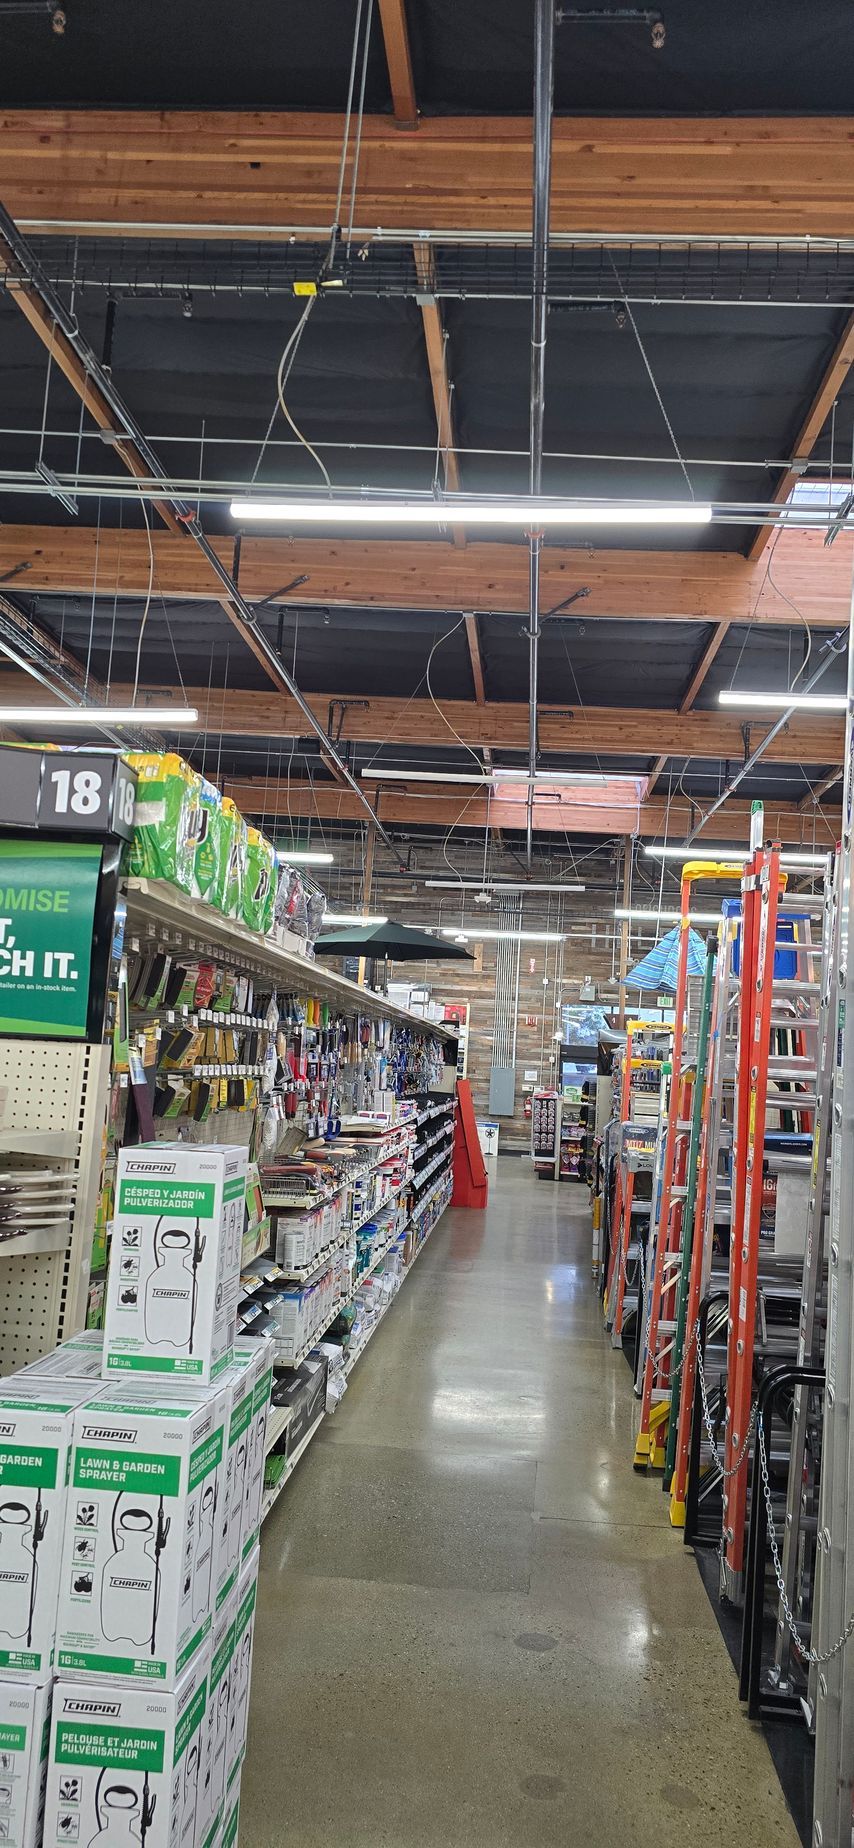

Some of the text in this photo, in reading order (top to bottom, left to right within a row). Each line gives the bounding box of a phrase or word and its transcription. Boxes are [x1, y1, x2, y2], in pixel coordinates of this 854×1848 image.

[51, 770, 102, 815] 18
[118, 778, 135, 825] 18
[0, 888, 70, 913] MISE
[43, 951, 78, 980] IT.
[36, 983, 60, 991] in-stock
[129, 1162, 173, 1173] CHAPIN
[124, 1186, 206, 1200] CÉSPED Y JARDÍN
[124, 1198, 194, 1209] PULVERIZADOR
[154, 1290, 188, 1298] CHAPIN
[41, 1425, 62, 1433] 20000
[86, 1428, 134, 1441] CHAPIN
[163, 1432, 183, 1440] 20000
[0, 1454, 43, 1467] GARDEN
[80, 1457, 165, 1475] LAWN & GARDEN
[79, 1469, 127, 1482] SPRAYER
[112, 1578, 149, 1589] CHAPIN
[22, 1658, 36, 1666] USA
[60, 1654, 87, 1667] 1G 3.8L
[147, 1665, 161, 1674] USA
[9, 1700, 30, 1709] 20000
[67, 1702, 118, 1714] CHAPIN
[146, 1705, 167, 1714] 20000
[0, 1732, 20, 1743] AYER
[61, 1732, 158, 1751] PELOUSE ET JARDIN
[61, 1742, 138, 1759] PULVÉRISATEUR
